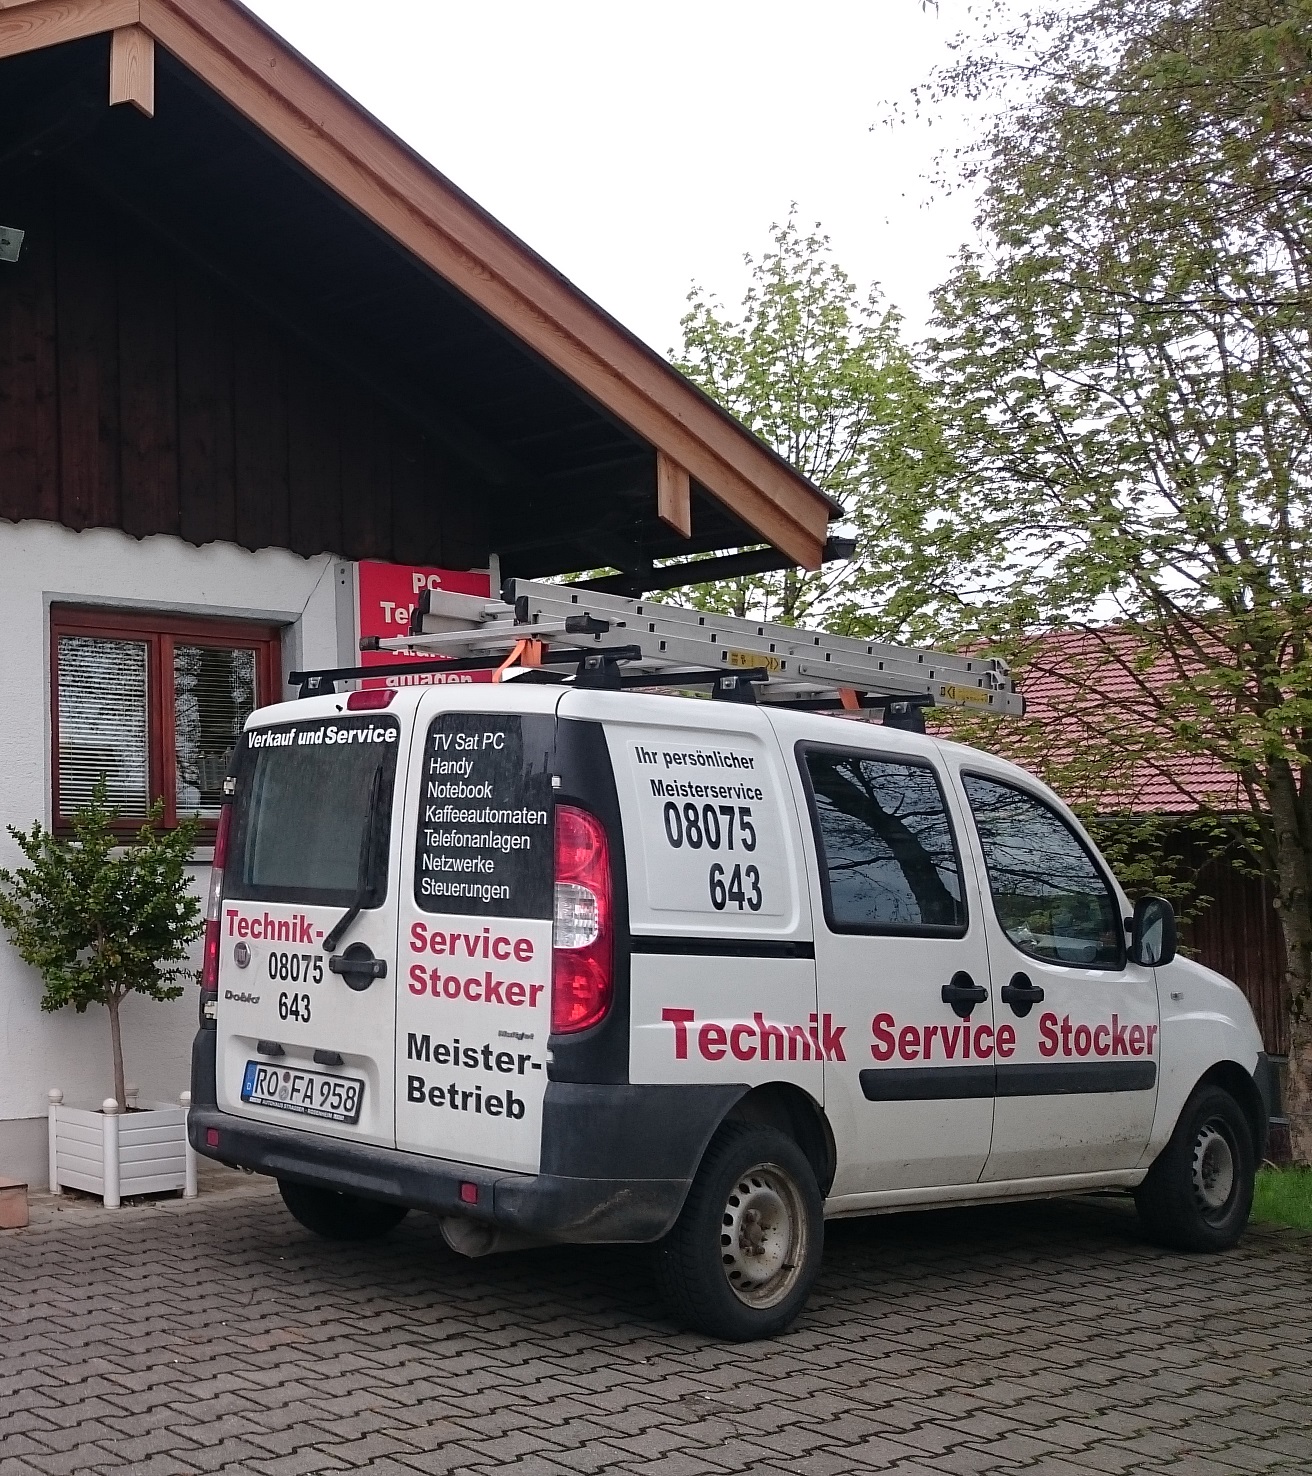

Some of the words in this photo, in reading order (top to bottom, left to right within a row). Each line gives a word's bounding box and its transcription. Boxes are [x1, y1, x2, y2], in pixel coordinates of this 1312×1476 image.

[412, 573, 441, 594] PC
[248, 728, 297, 748] Verkauf
[298, 726, 324, 745] und
[325, 724, 398, 744] Service
[433, 733, 453, 750] TV
[455, 733, 479, 750] Sat
[482, 732, 505, 749] PC
[429, 757, 474, 778] Handy
[634, 746, 658, 764] Ihr
[663, 750, 755, 769] persönlicher
[427, 781, 493, 798] Notebook
[650, 778, 763, 801] Meisterservice
[425, 805, 548, 825] Kaffeeautomaten
[663, 801, 757, 852] 08075
[423, 829, 531, 853] Telefonanlagen
[422, 853, 495, 873] Netzwerke
[421, 877, 510, 903] Steuerungen
[709, 862, 763, 911] 643
[226, 909, 324, 944] Technik-
[409, 922, 534, 962] Service
[268, 951, 324, 985] 08075
[408, 964, 545, 1008] Stocker
[278, 991, 312, 1024] 643
[662, 1008, 846, 1062] Technik
[870, 1012, 1016, 1062] Service
[1038, 1012, 1158, 1058] Stocker
[407, 1032, 542, 1075] Meister-
[254, 1068, 279, 1097] RO
[289, 1075, 315, 1105] FA
[319, 1081, 357, 1113] 958
[407, 1075, 526, 1120] Betrieb
